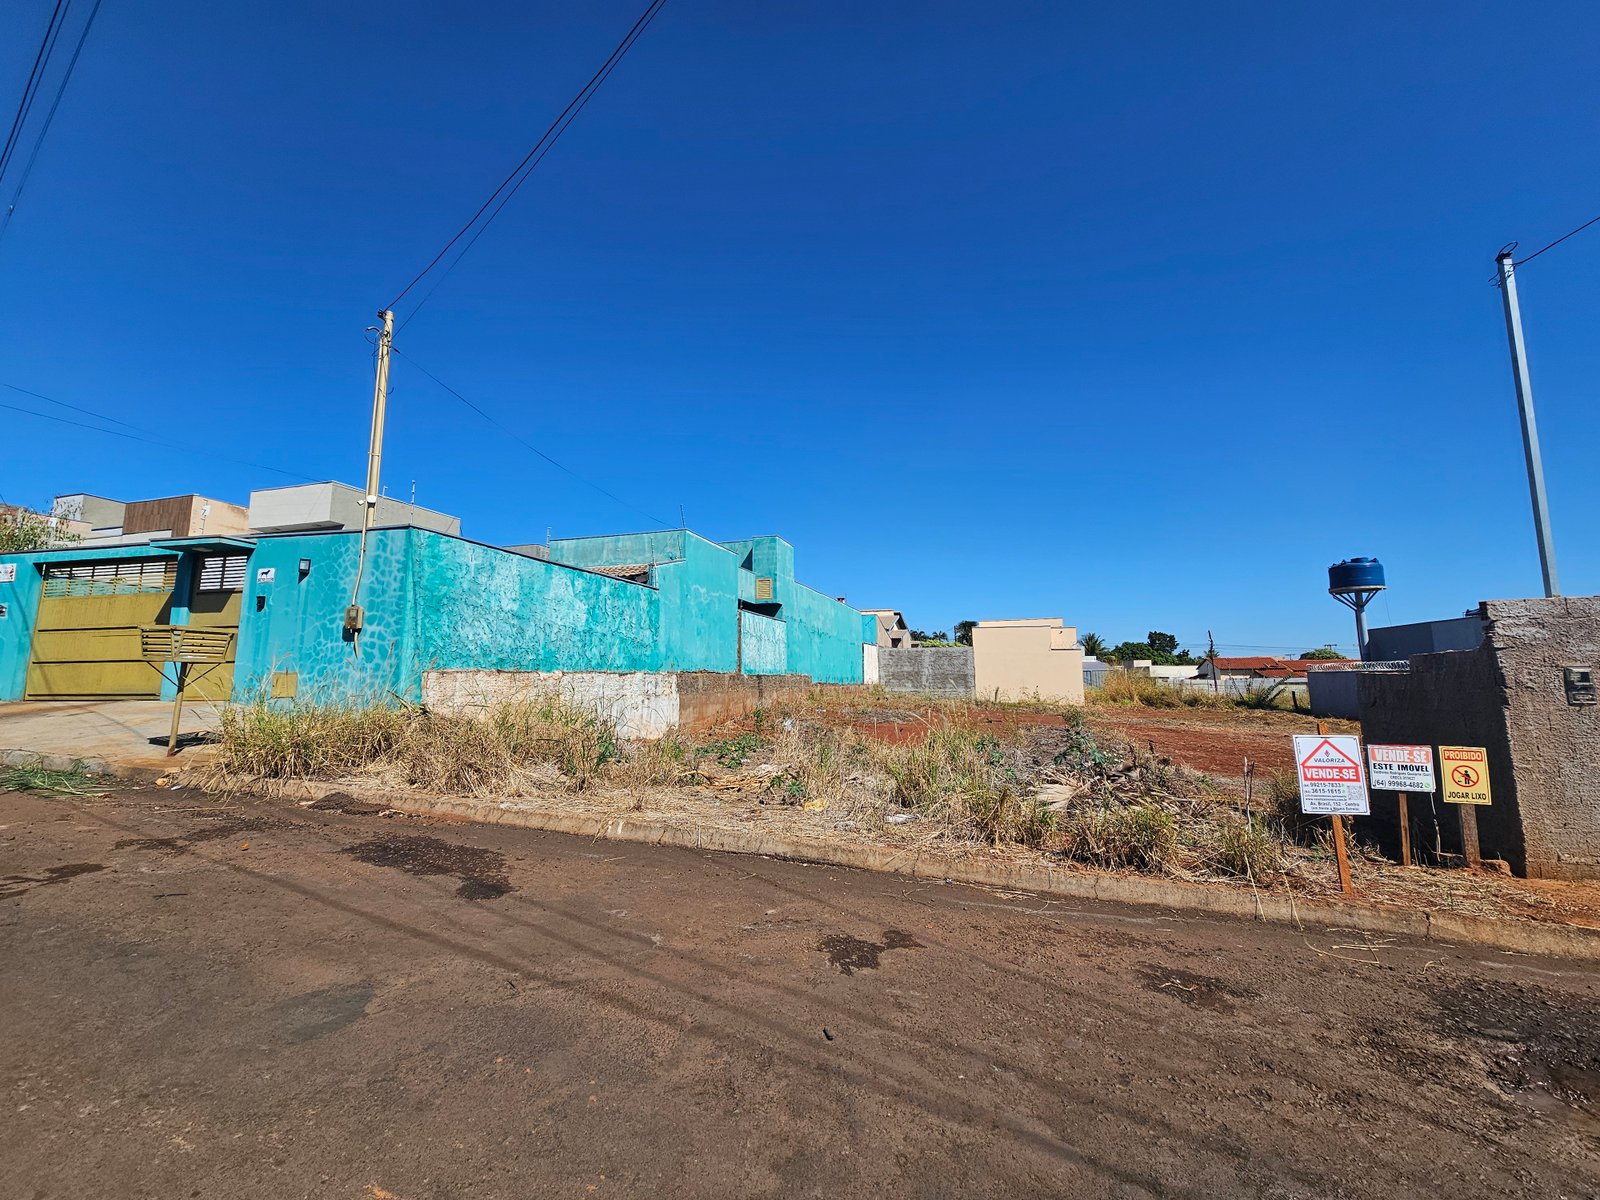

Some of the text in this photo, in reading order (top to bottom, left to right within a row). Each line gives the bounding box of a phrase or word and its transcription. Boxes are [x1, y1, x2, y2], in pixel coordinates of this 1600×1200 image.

[1374, 749, 1427, 763] VENDE-SE
[1444, 750, 1482, 761] PROIBIDO
[1373, 763, 1430, 772] ESTE IMÓVEL
[1304, 768, 1357, 780] VENDE-SE
[1448, 791, 1487, 800] JOGAR LIXO
